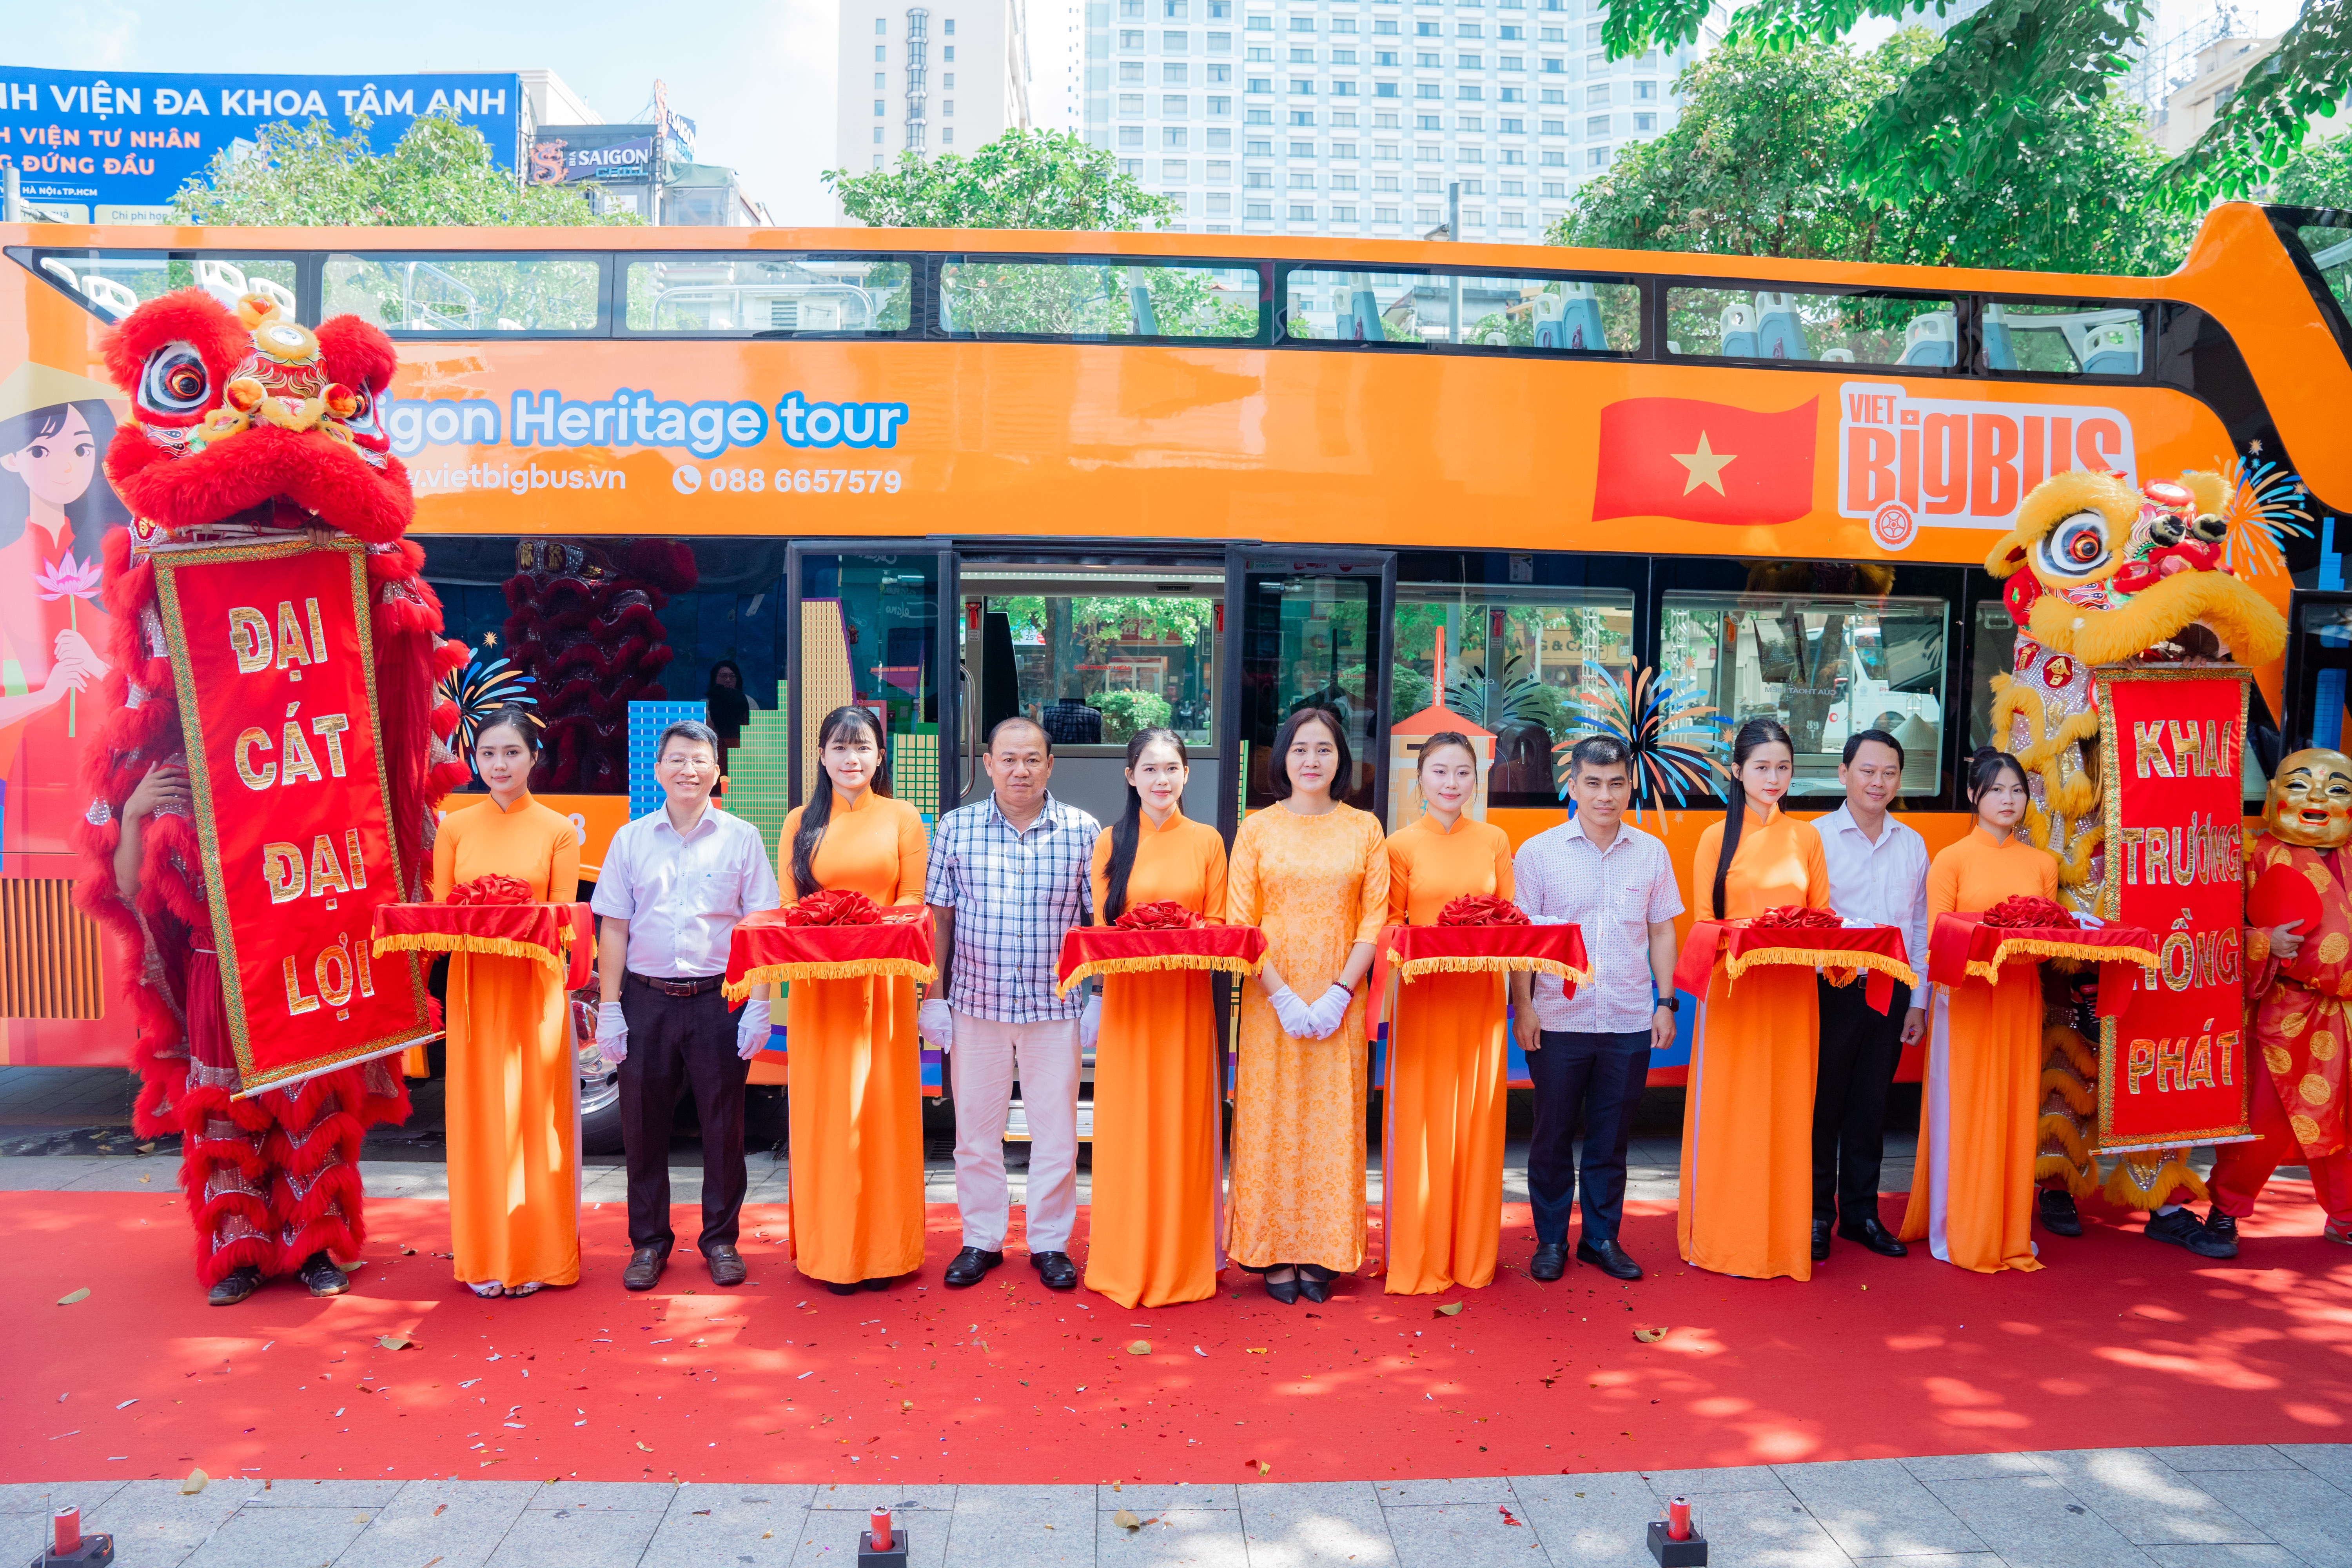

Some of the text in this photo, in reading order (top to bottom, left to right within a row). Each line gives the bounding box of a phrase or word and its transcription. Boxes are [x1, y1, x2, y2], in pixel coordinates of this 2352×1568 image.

[50, 80, 141, 120] VIỆN
[153, 89, 210, 116] ĐA
[222, 89, 327, 116] KHOA
[338, 83, 414, 116] TÂM
[425, 89, 505, 115] ANH
[20, 124, 79, 149] VIỆN
[89, 128, 122, 147] TƯ
[131, 127, 200, 148] NHÂN
[578, 149, 648, 166] SAIGON
[21, 152, 94, 174] ĐỨNG
[103, 152, 154, 175] ĐẦU
[378, 395, 900, 453] igon Heritage tour
[1848, 394, 1897, 425] VIET
[406, 463, 626, 495] w.vietbigbus.vn
[710, 469, 901, 494] 088 6657579
[229, 597, 328, 682] ĐẠI
[235, 701, 348, 790] CÁT
[2134, 720, 2233, 778] KHAI
[568, 813, 586, 846] 8
[2121, 811, 2241, 886] TRƯƠNG
[263, 828, 367, 911] ĐẠI
[283, 931, 375, 1021] LỢI
[2128, 1018, 2239, 1094] PHÁT
